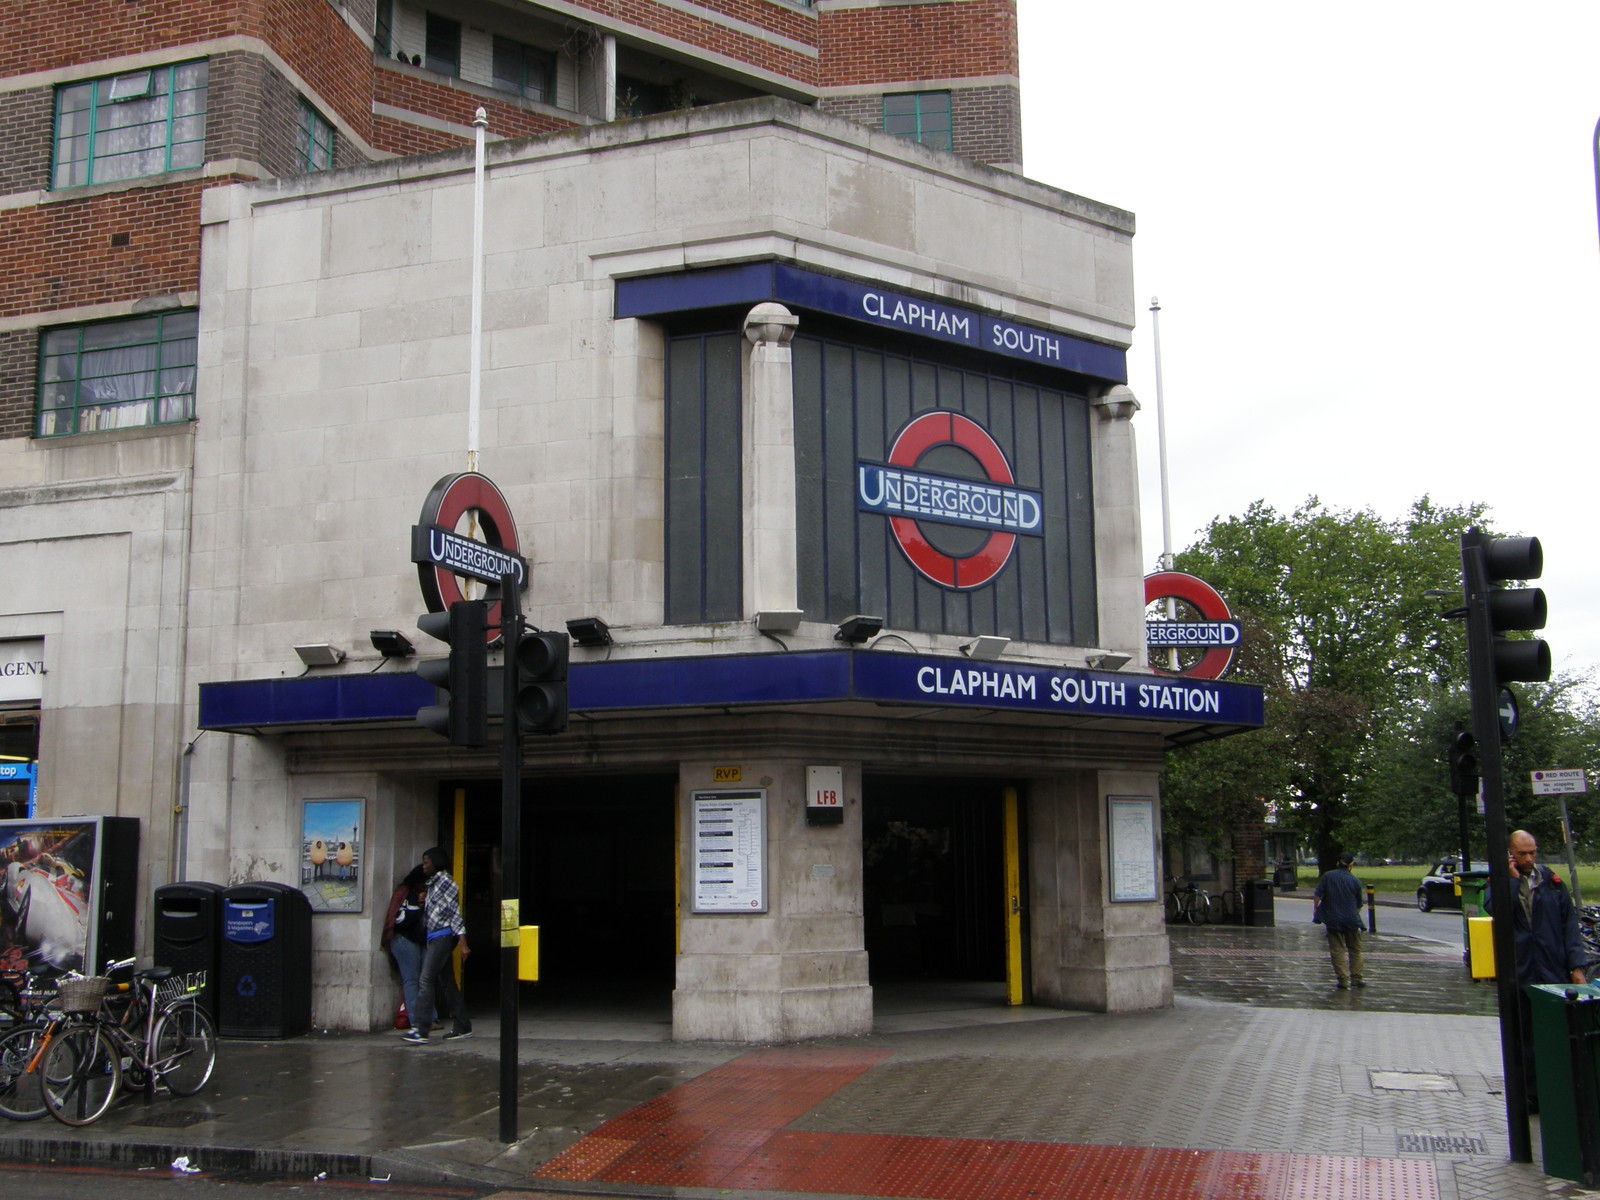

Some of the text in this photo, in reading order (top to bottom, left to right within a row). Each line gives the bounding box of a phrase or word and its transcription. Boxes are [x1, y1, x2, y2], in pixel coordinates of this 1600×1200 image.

[862, 293, 1060, 361] CLAPHAM SOUTH
[859, 467, 1040, 529] UNDERGROUND
[430, 529, 524, 585] UNDERGROUND
[1146, 623, 1239, 645] ERGROUND
[917, 666, 1220, 713] CLAPHAM SOUTH STATION
[0, 766, 17, 777] top
[716, 768, 739, 779] RVP
[817, 790, 837, 805] LFB
